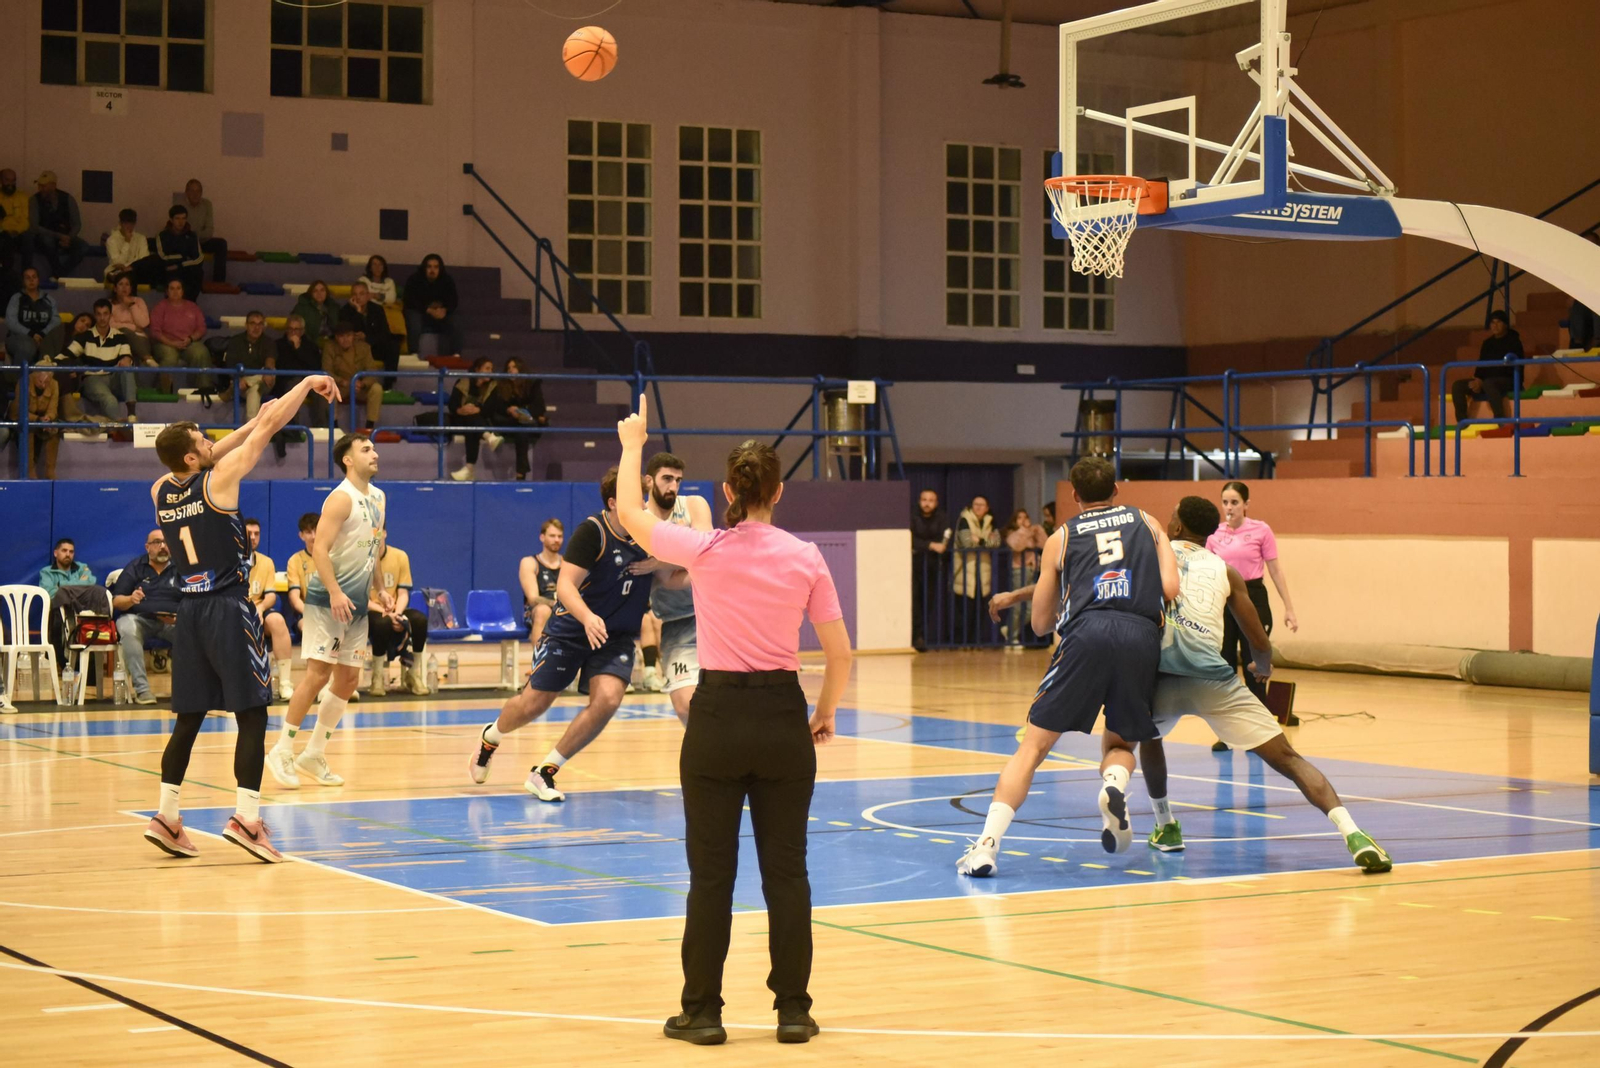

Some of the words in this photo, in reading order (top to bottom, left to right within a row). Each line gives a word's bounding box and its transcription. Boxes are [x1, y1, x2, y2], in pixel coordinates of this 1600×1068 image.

[106, 101, 112, 110] 4
[176, 500, 204, 519] STROG
[1099, 512, 1134, 528] STROG
[179, 526, 199, 565] 1
[1095, 530, 1124, 565] 5
[621, 580, 633, 596] 0
